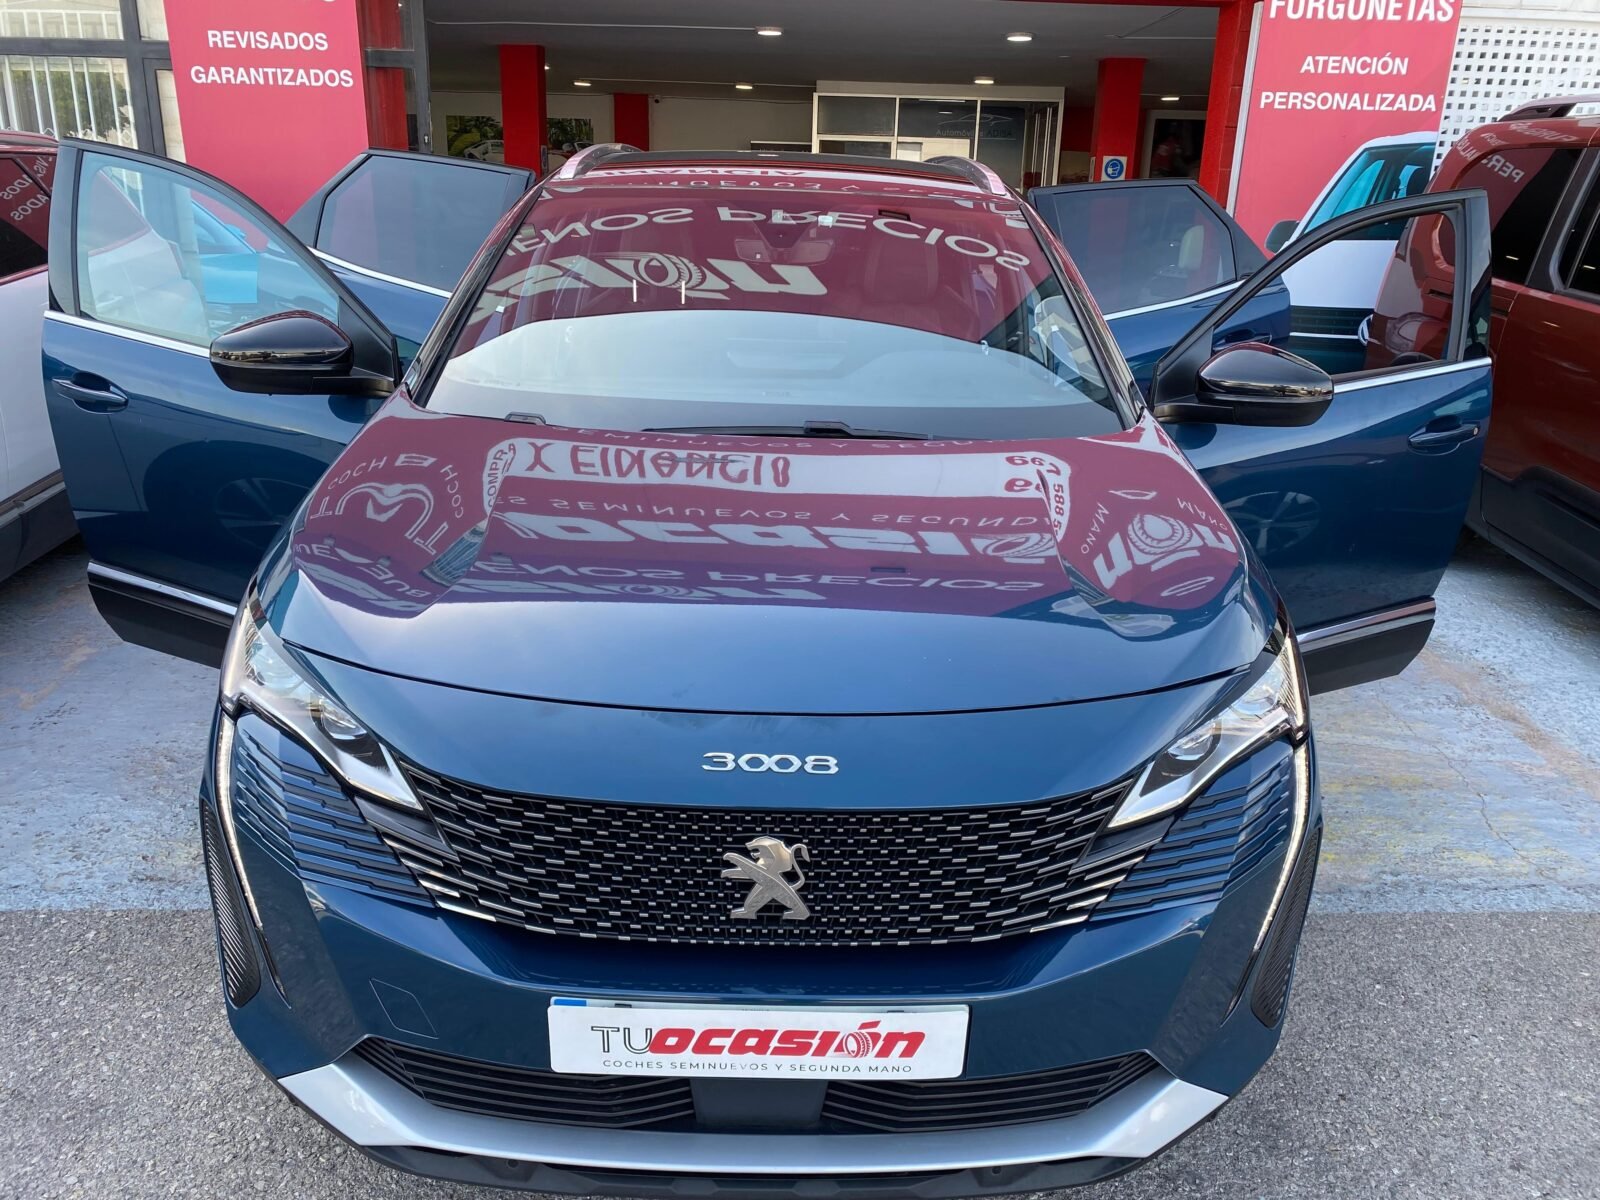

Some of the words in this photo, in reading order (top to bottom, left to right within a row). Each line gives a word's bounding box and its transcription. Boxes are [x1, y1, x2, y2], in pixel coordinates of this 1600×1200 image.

[1269, 0, 1456, 22] FURGONETAS
[206, 30, 328, 51] REVISADOS
[1300, 52, 1409, 75] ATENCIÓN
[190, 65, 354, 87] GARANTIZADOS
[1259, 91, 1437, 112] PERSONALIZADA
[701, 752, 840, 775] 3008
[603, 1060, 664, 1069] COCHES
[670, 1062, 768, 1070] SEMINUEVOS
[789, 1064, 861, 1072] SEGUNDA
[868, 1065, 912, 1073] MANO
